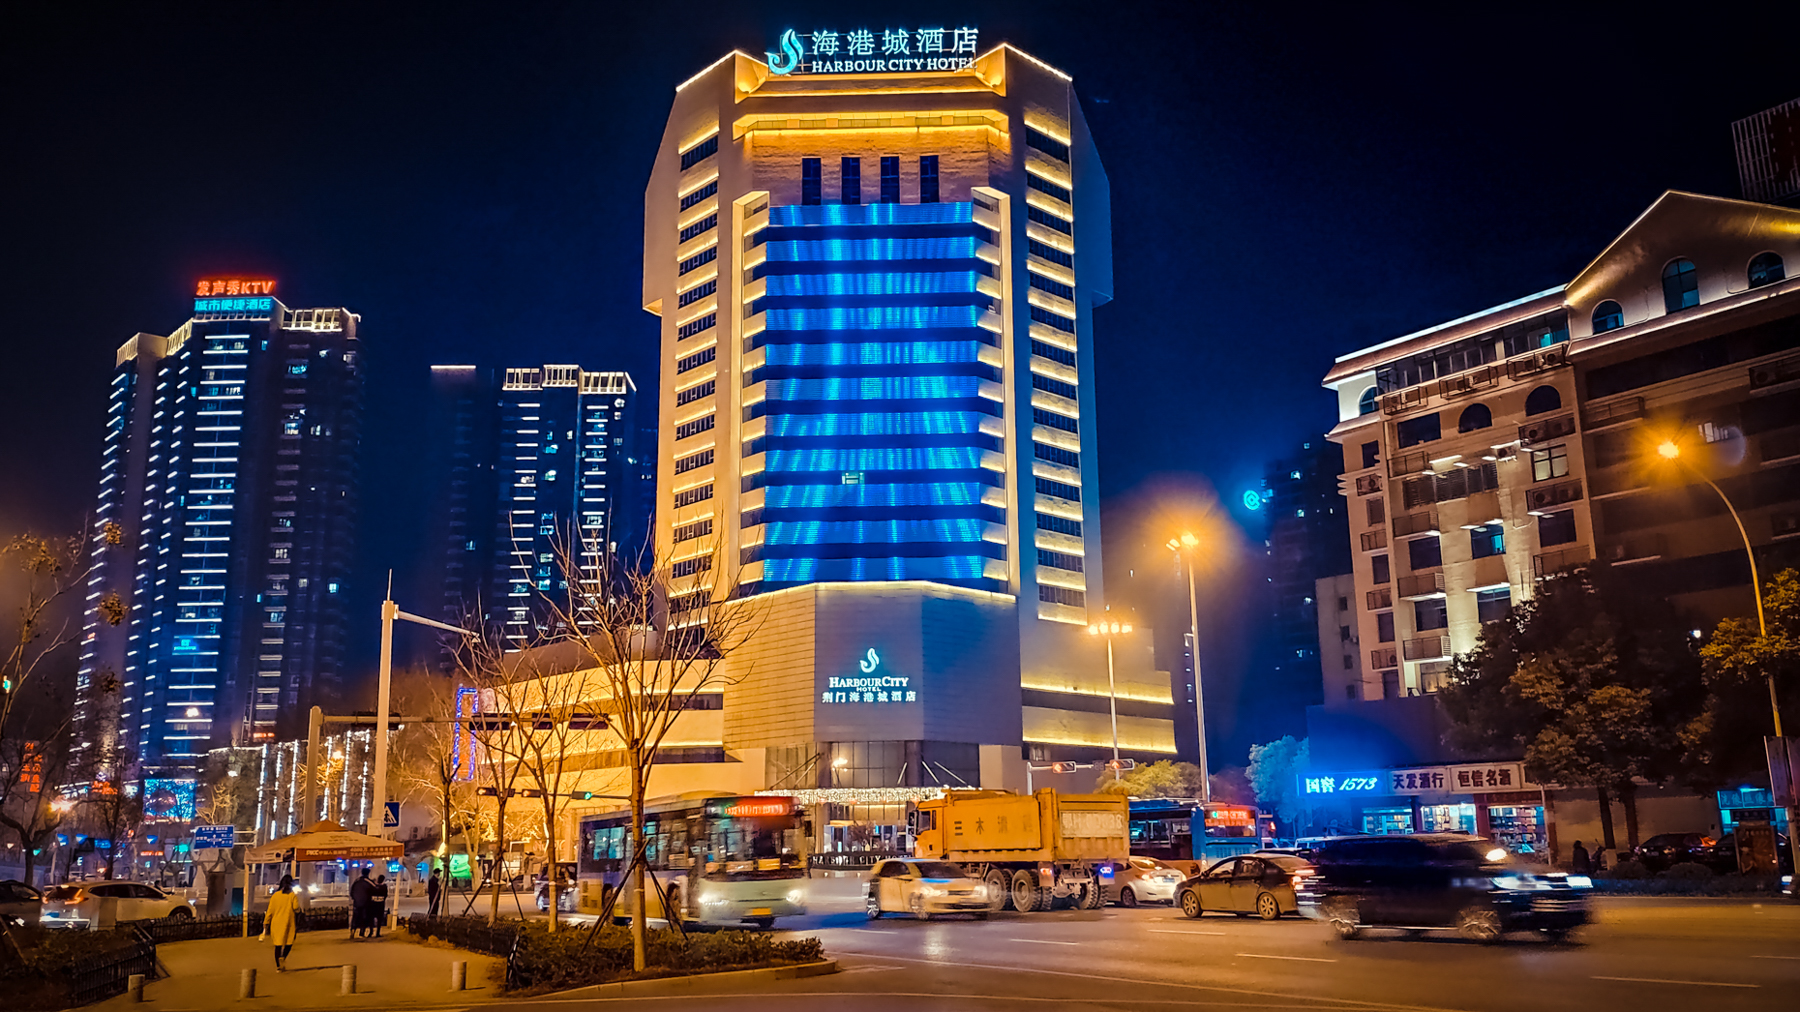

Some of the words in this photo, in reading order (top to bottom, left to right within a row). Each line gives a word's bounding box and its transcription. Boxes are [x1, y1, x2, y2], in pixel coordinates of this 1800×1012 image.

[811, 26, 979, 56] 海港城酒店
[811, 59, 887, 73] HARBOUR
[888, 58, 925, 72] CITY
[196, 280, 273, 296] 发声秀KTV
[194, 298, 272, 312] 城市便捷酒店
[821, 690, 917, 703] 荆门海港城酒店
[1338, 776, 1378, 792] 1573
[1457, 768, 1512, 788] 恒信名酒
